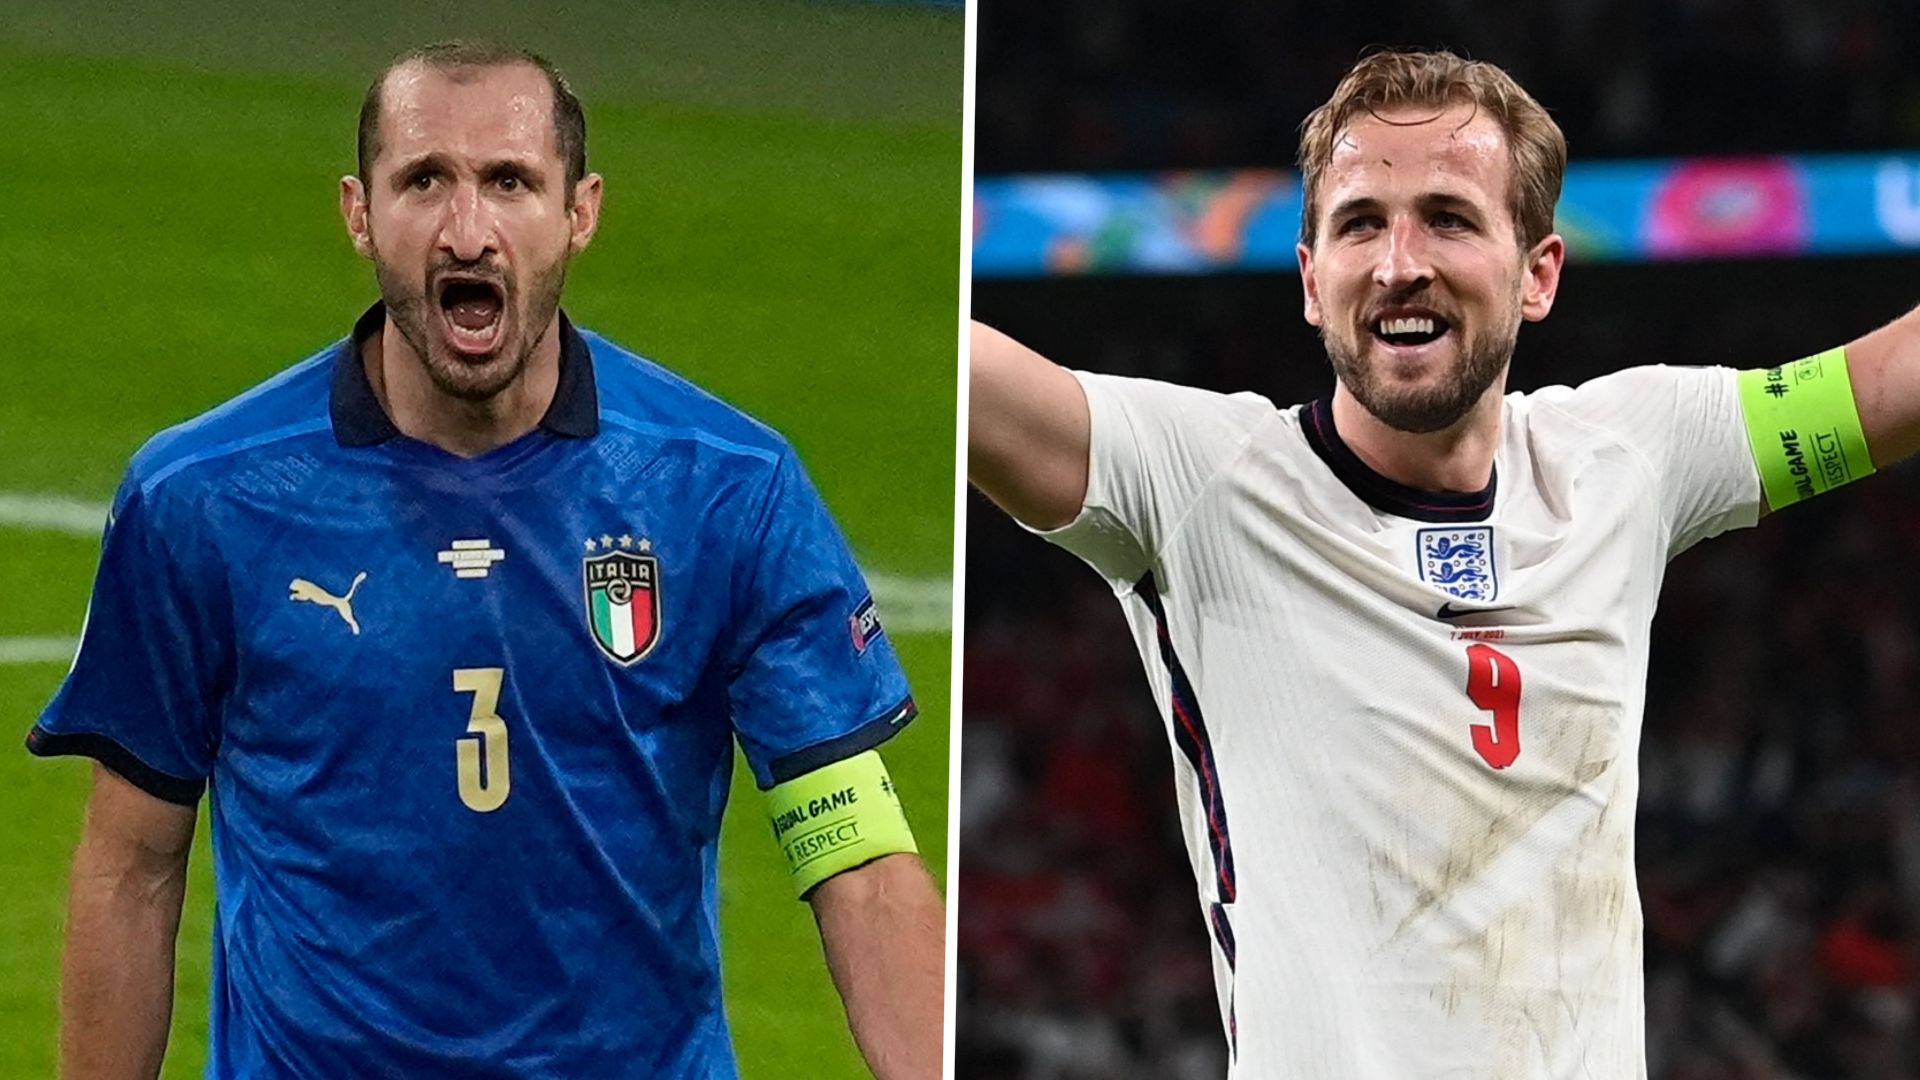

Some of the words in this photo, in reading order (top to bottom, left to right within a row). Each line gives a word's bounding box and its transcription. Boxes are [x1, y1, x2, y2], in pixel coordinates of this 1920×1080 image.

[589, 562, 650, 581] ITALIA
[1483, 629, 1505, 639] 2021
[1466, 643, 1522, 769] 9
[453, 668, 510, 812] 3
[793, 822, 858, 861] RESPECT
